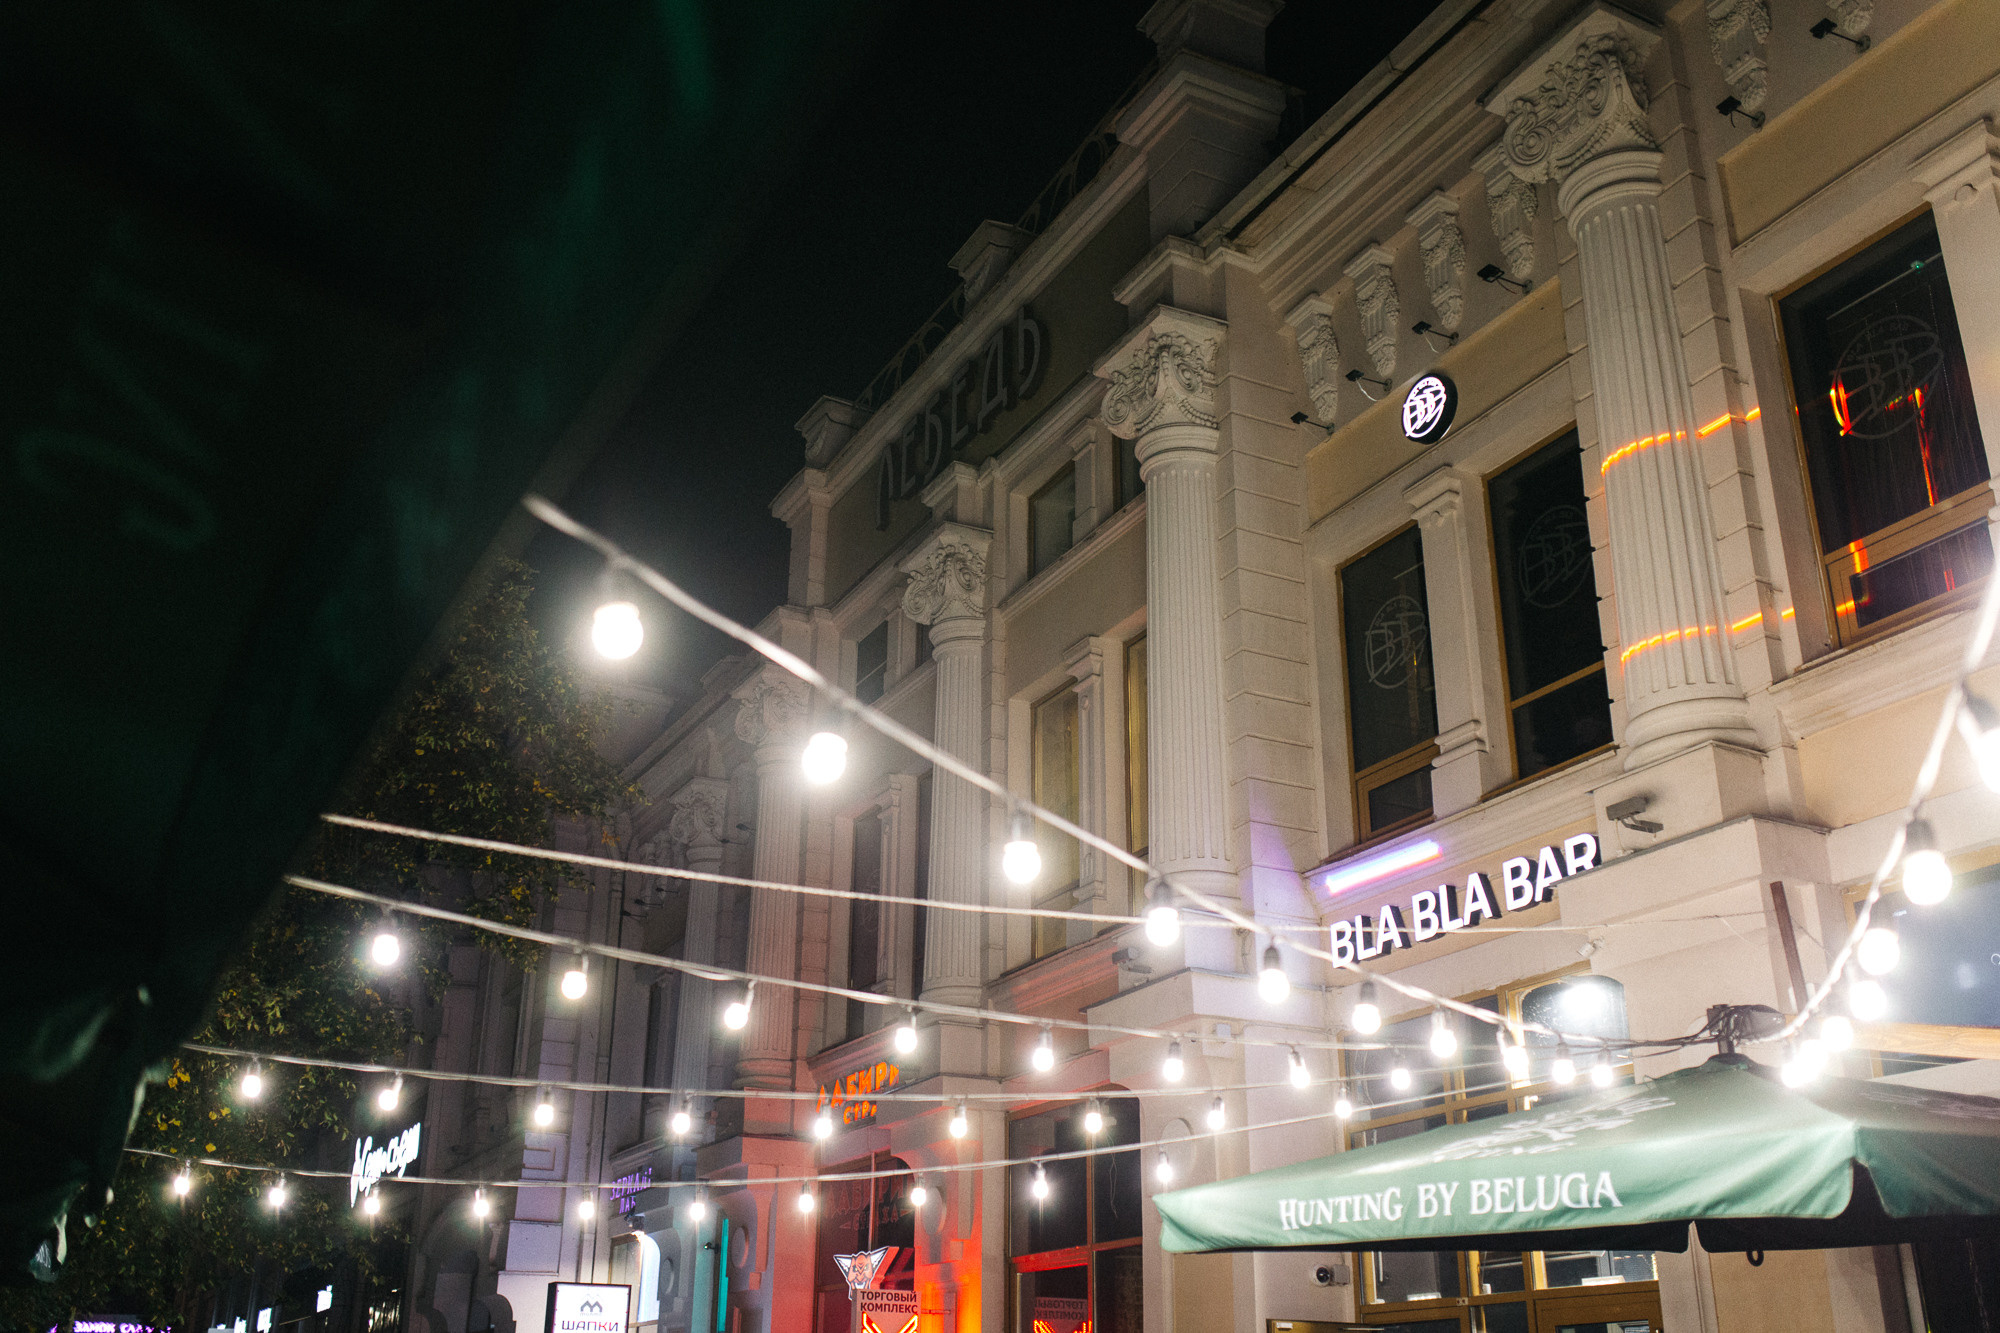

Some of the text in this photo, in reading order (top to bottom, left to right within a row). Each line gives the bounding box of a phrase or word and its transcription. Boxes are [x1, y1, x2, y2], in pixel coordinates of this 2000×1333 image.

[876, 306, 1041, 530] ЛЕБЕДЬ
[1330, 833, 1598, 968] BLA BLA BAR
[1279, 1171, 1623, 1231] HUNTING BY BELUGA
[860, 1291, 917, 1303] ТОРГОВЫЙ
[860, 1303, 918, 1314] КОМПЛЕКС
[562, 1320, 619, 1332] ШАПКИ
